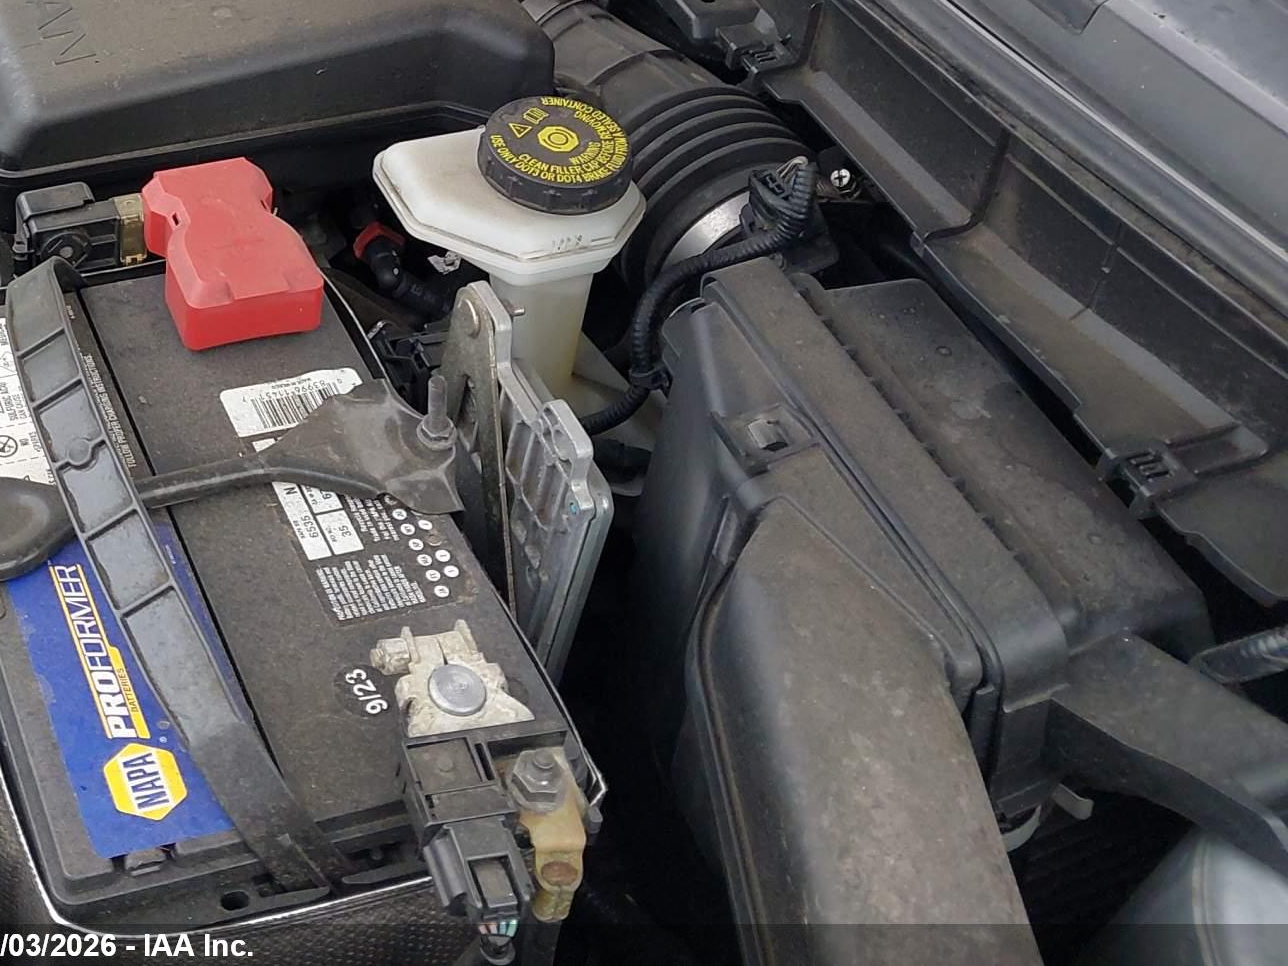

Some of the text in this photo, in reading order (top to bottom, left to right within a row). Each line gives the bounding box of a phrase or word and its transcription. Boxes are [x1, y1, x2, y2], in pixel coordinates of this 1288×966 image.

[541, 97, 592, 113] CONTAINER
[591, 110, 621, 132] SEALED
[490, 134, 505, 147] USE
[518, 110, 614, 176] CLEAN FILLER CAP BEFORE REMOVING
[497, 147, 519, 163] ONLY
[568, 141, 600, 164] WARNING
[514, 161, 539, 176] DOT3
[540, 171, 555, 180] OR
[557, 173, 582, 183] DOT4
[582, 166, 612, 181] BRAKE
[294, 379, 325, 394] 83996
[1, 395, 18, 421] SULFURIC
[16, 407, 27, 419] CAN
[99, 392, 117, 421] CHARGING
[110, 420, 126, 444] PROPER
[19, 438, 29, 446] NO
[119, 443, 136, 468] FOLLOW
[283, 486, 298, 496] N
[300, 513, 319, 539] 6535
[338, 524, 351, 537] 35
[53, 563, 136, 739] PROFORMER
[116, 668, 138, 712] BATTERIES
[345, 668, 387, 714] 9/23
[121, 752, 169, 810] NAPA
